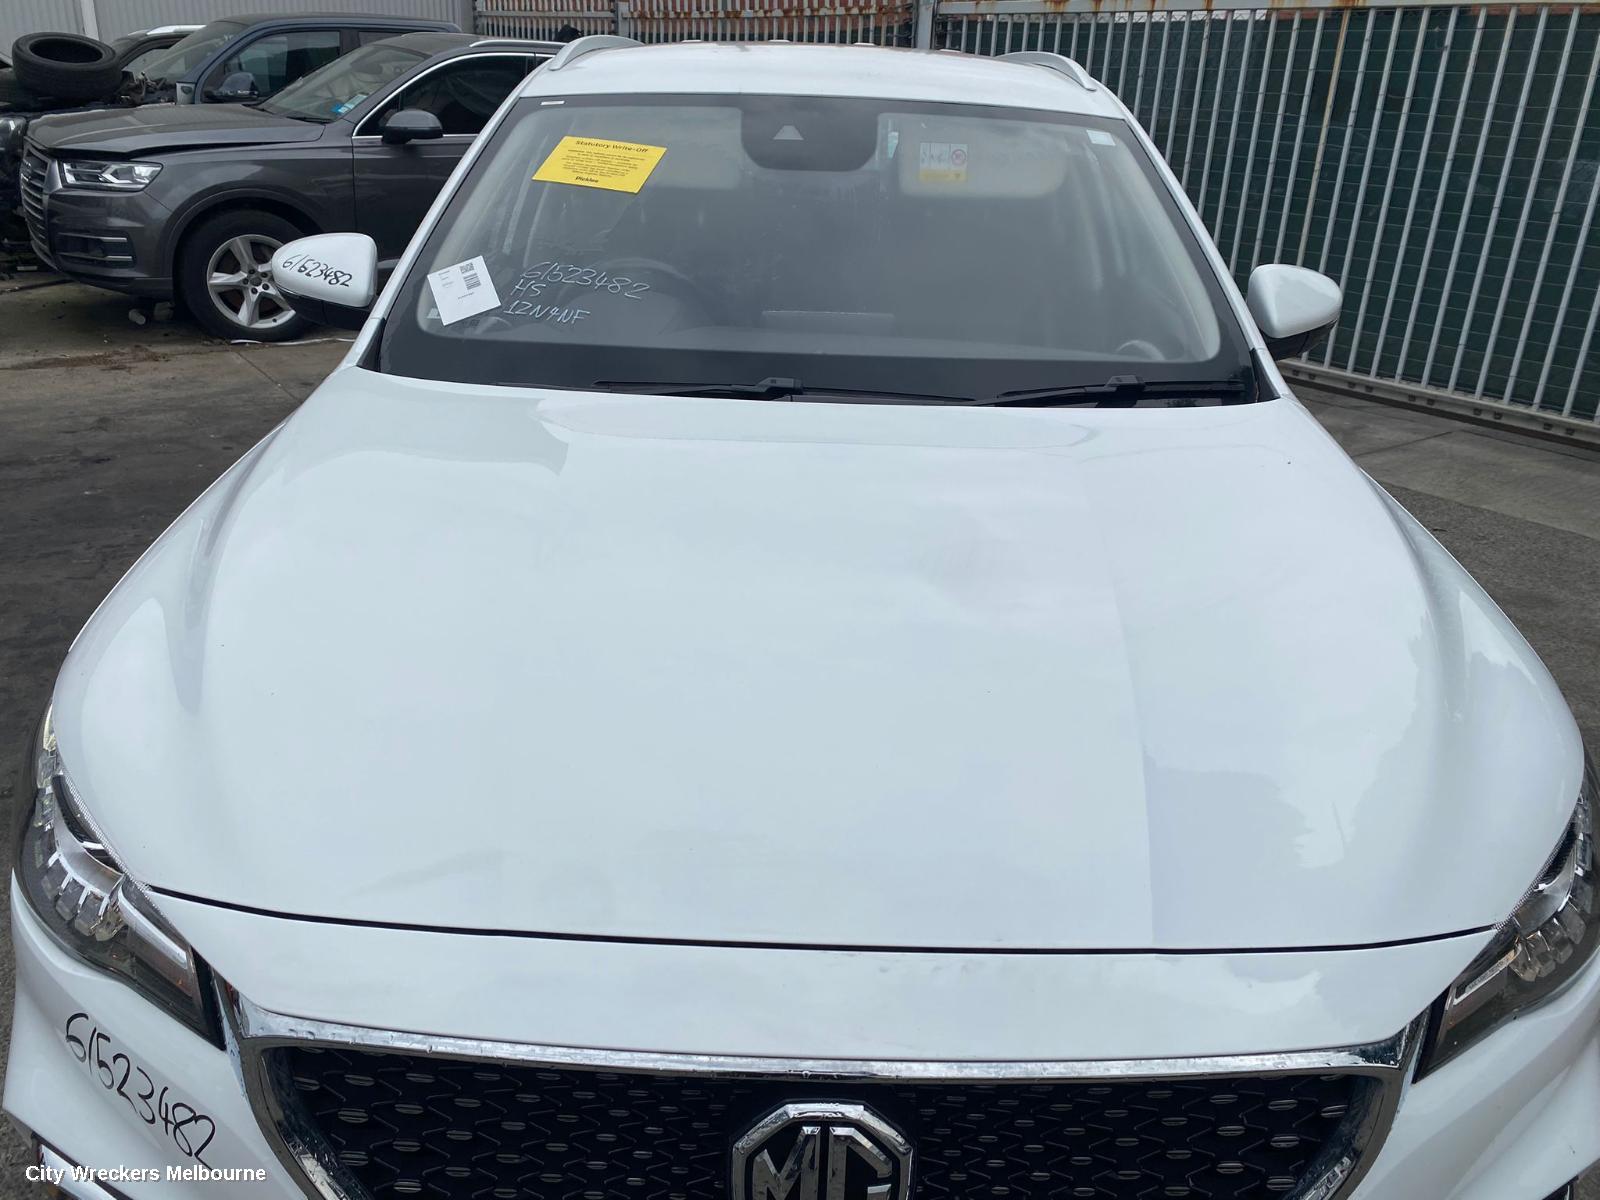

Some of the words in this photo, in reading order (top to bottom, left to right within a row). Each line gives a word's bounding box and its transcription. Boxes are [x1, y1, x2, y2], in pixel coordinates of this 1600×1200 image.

[575, 140, 611, 149] Statutory
[612, 144, 649, 153] Write-Off
[510, 278, 547, 298] HS
[752, 1126, 893, 1200] MG
